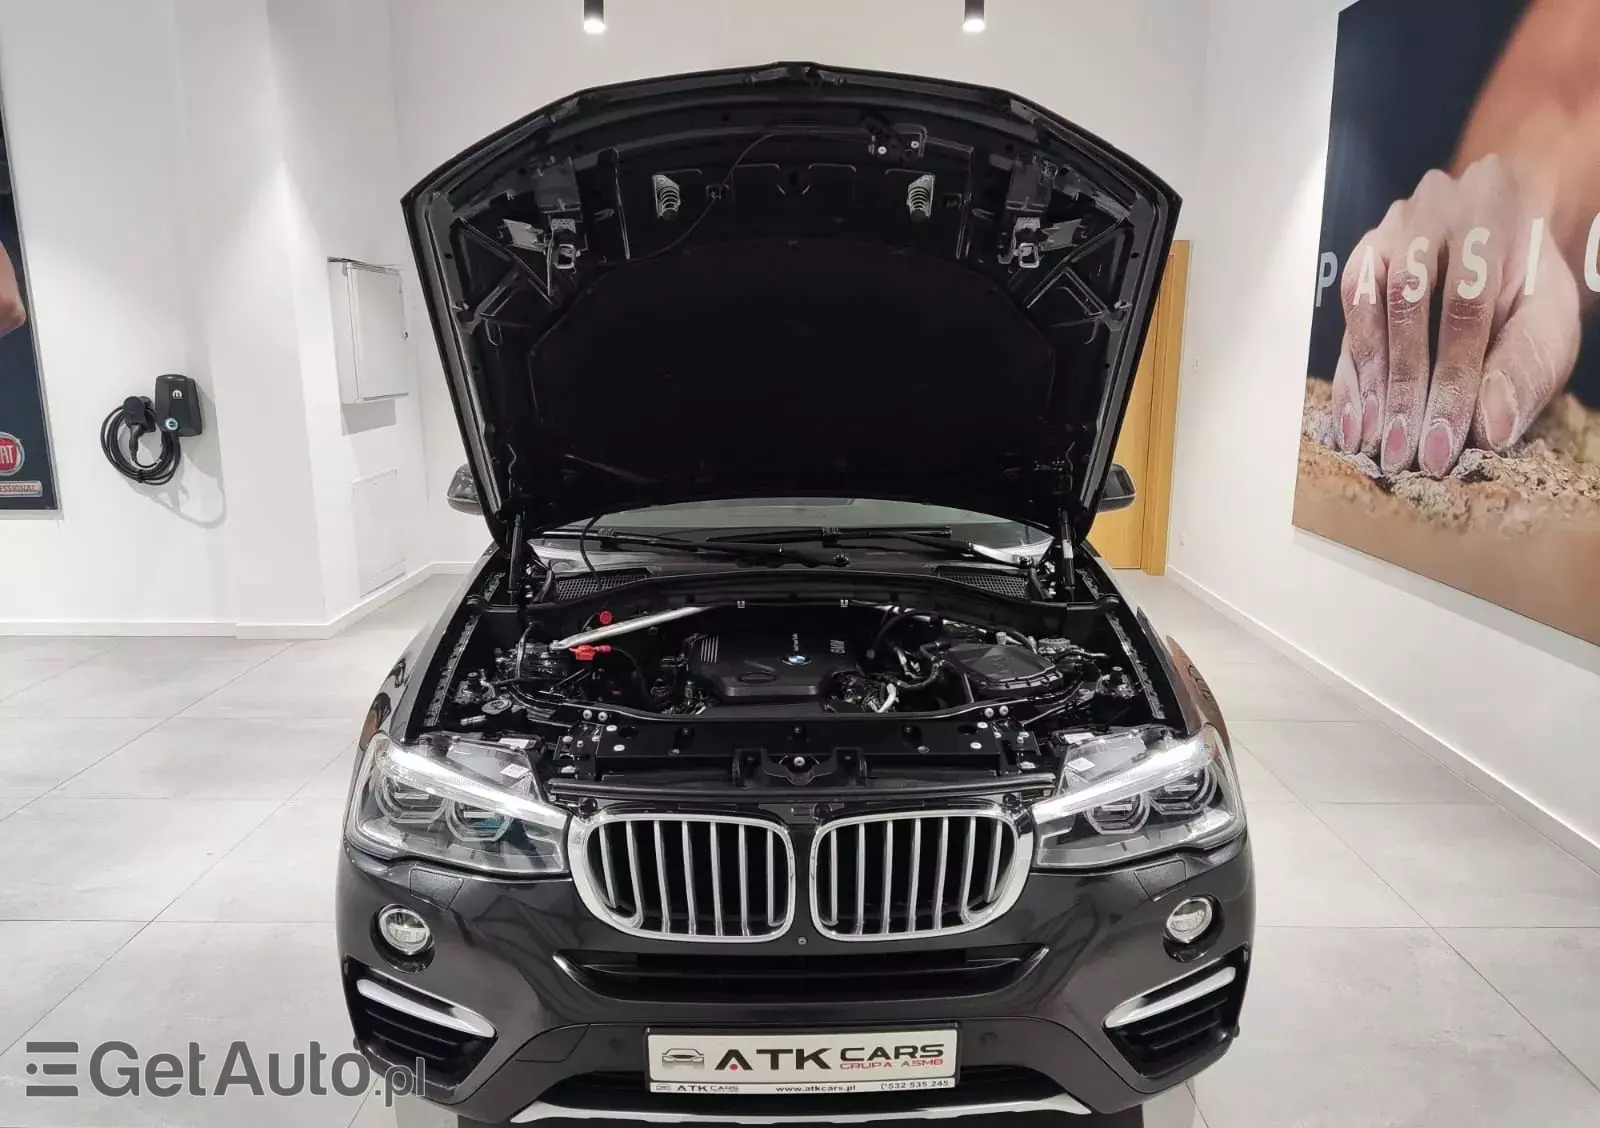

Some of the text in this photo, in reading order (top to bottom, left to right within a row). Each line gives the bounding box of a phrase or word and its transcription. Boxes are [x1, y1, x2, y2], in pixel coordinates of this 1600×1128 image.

[714, 1043, 945, 1071] ATK CARS
[840, 1058, 944, 1070] GRUPA ASMB
[677, 1084, 740, 1093] ATK CARS
[775, 1084, 856, 1093] www.atkcars.pl
[888, 1082, 906, 1090] 532
